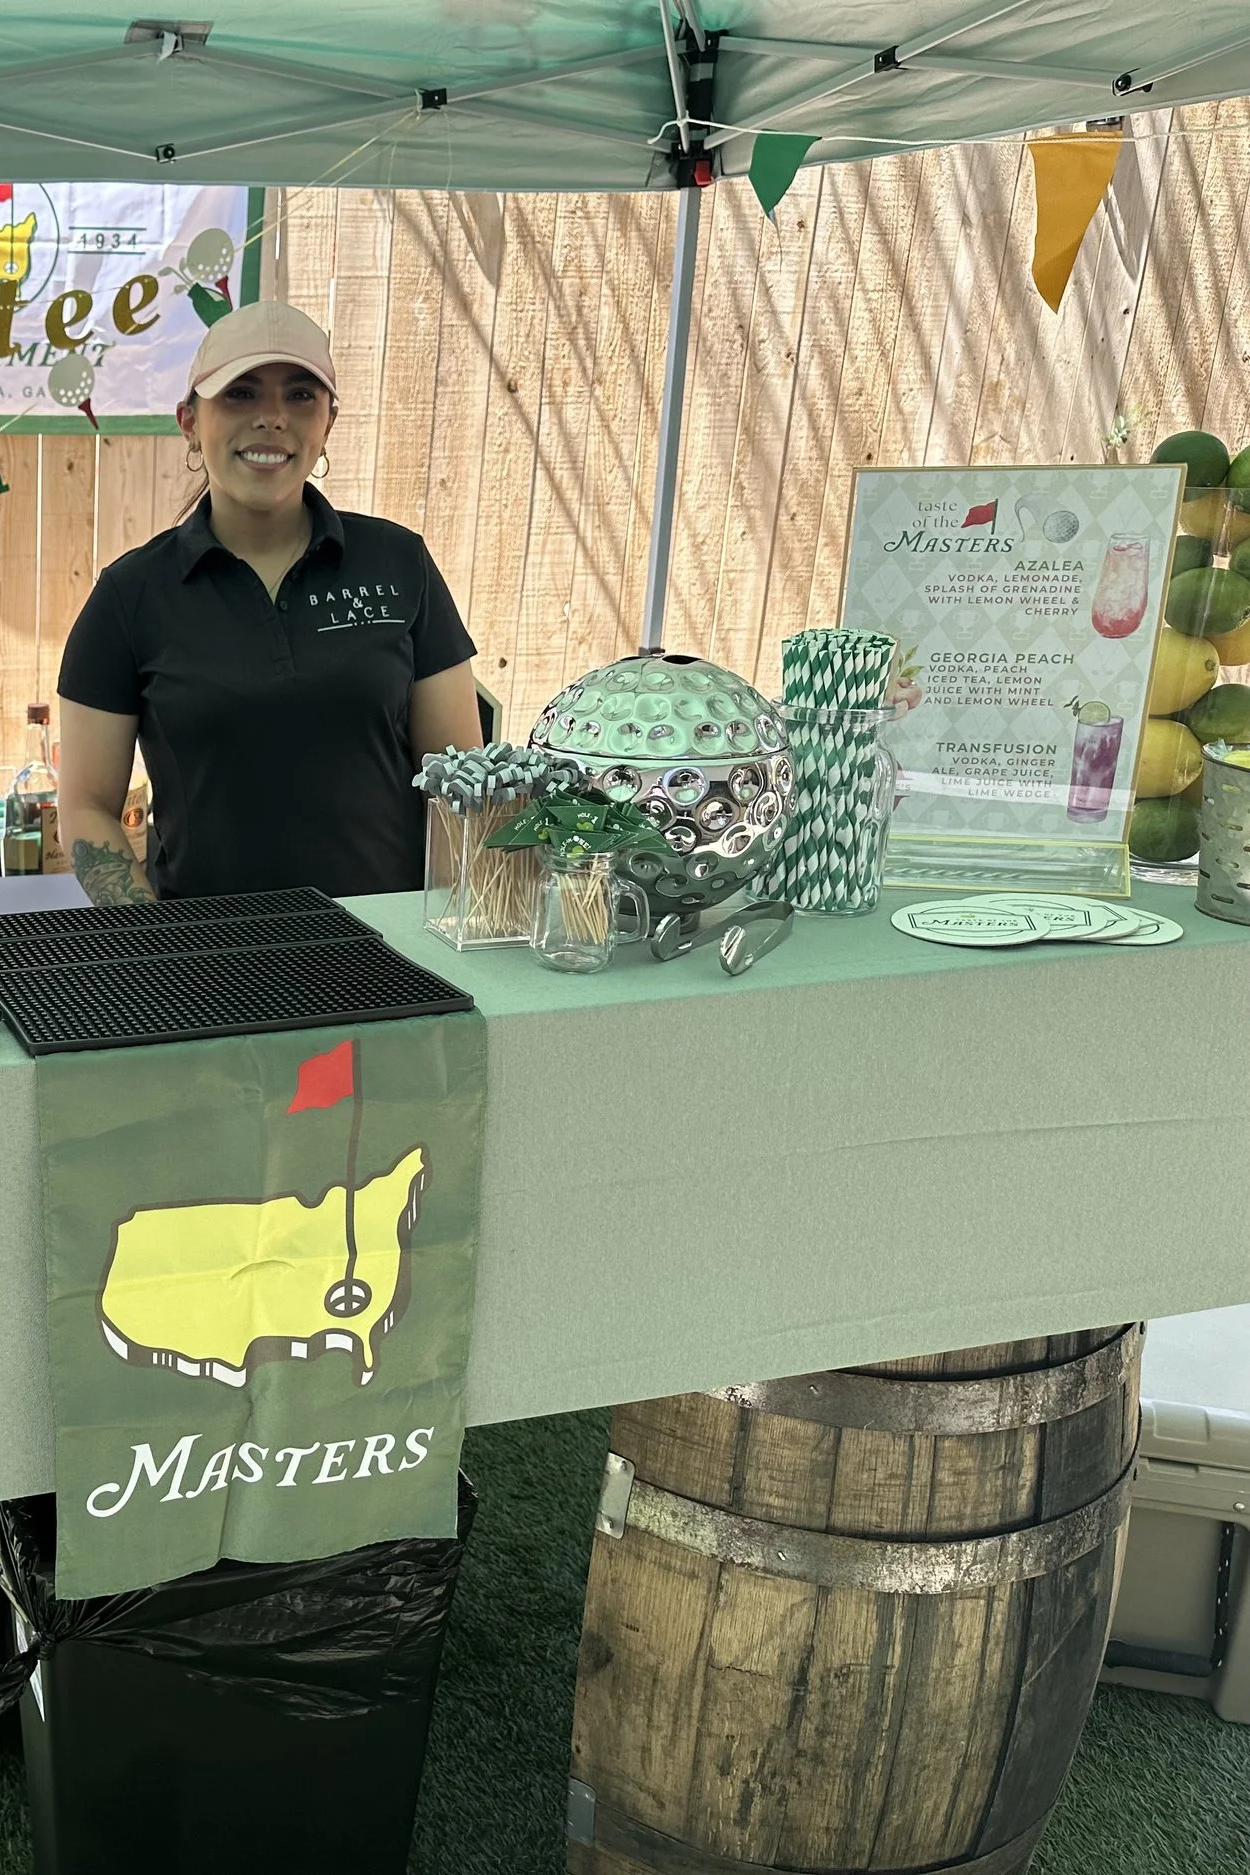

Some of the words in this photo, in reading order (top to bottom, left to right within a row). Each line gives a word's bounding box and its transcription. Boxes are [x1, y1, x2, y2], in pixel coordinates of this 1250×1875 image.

[80, 233, 138, 249] 1934
[918, 501, 958, 512] taste
[912, 516, 929, 528] of
[934, 515, 959, 528] the
[883, 530, 1015, 553] MASTERS
[1014, 560, 1084, 571] AZALEA
[949, 574, 998, 584] VODKA,
[1004, 574, 1083, 584] LEMONADE,
[309, 584, 399, 606] BARREL
[924, 585, 974, 594] SPLASH
[980, 585, 998, 594] OF
[1002, 585, 1081, 594] GRENADINE
[353, 597, 364, 609] &
[928, 596, 964, 605] WITH
[967, 596, 1014, 605] LEMON
[1019, 596, 1067, 605] WHEEL
[1071, 597, 1080, 605] &
[330, 605, 390, 624] LACE
[1024, 607, 1079, 616] CHERRY
[930, 652, 1008, 664] GEORGIA
[1015, 653, 1075, 665] PEACH
[929, 664, 978, 674] VODKA,
[983, 665, 1028, 674] PEACH
[927, 675, 958, 684] ICED
[963, 676, 991, 685] TEA,
[996, 676, 1043, 685] LEMON
[925, 686, 963, 695] JUICE
[968, 686, 1002, 695] WITH
[1007, 687, 1041, 696] MINT
[924, 696, 952, 705] AND
[957, 697, 1002, 706] LEMON
[1008, 698, 1054, 707] WHEEL
[936, 742, 1057, 755] TRANSFUSION
[952, 756, 1001, 767] VODKA,
[1006, 758, 1056, 767] GINGER
[931, 767, 960, 776] ALE,
[964, 768, 1008, 777] GRAPE
[1012, 769, 1054, 779] JUICE,
[941, 777, 971, 786] LIME
[975, 779, 1013, 788] JUICE
[1018, 779, 1052, 789] WITH
[967, 788, 998, 797] LIME
[86, 1427, 435, 1518] MASTERS
